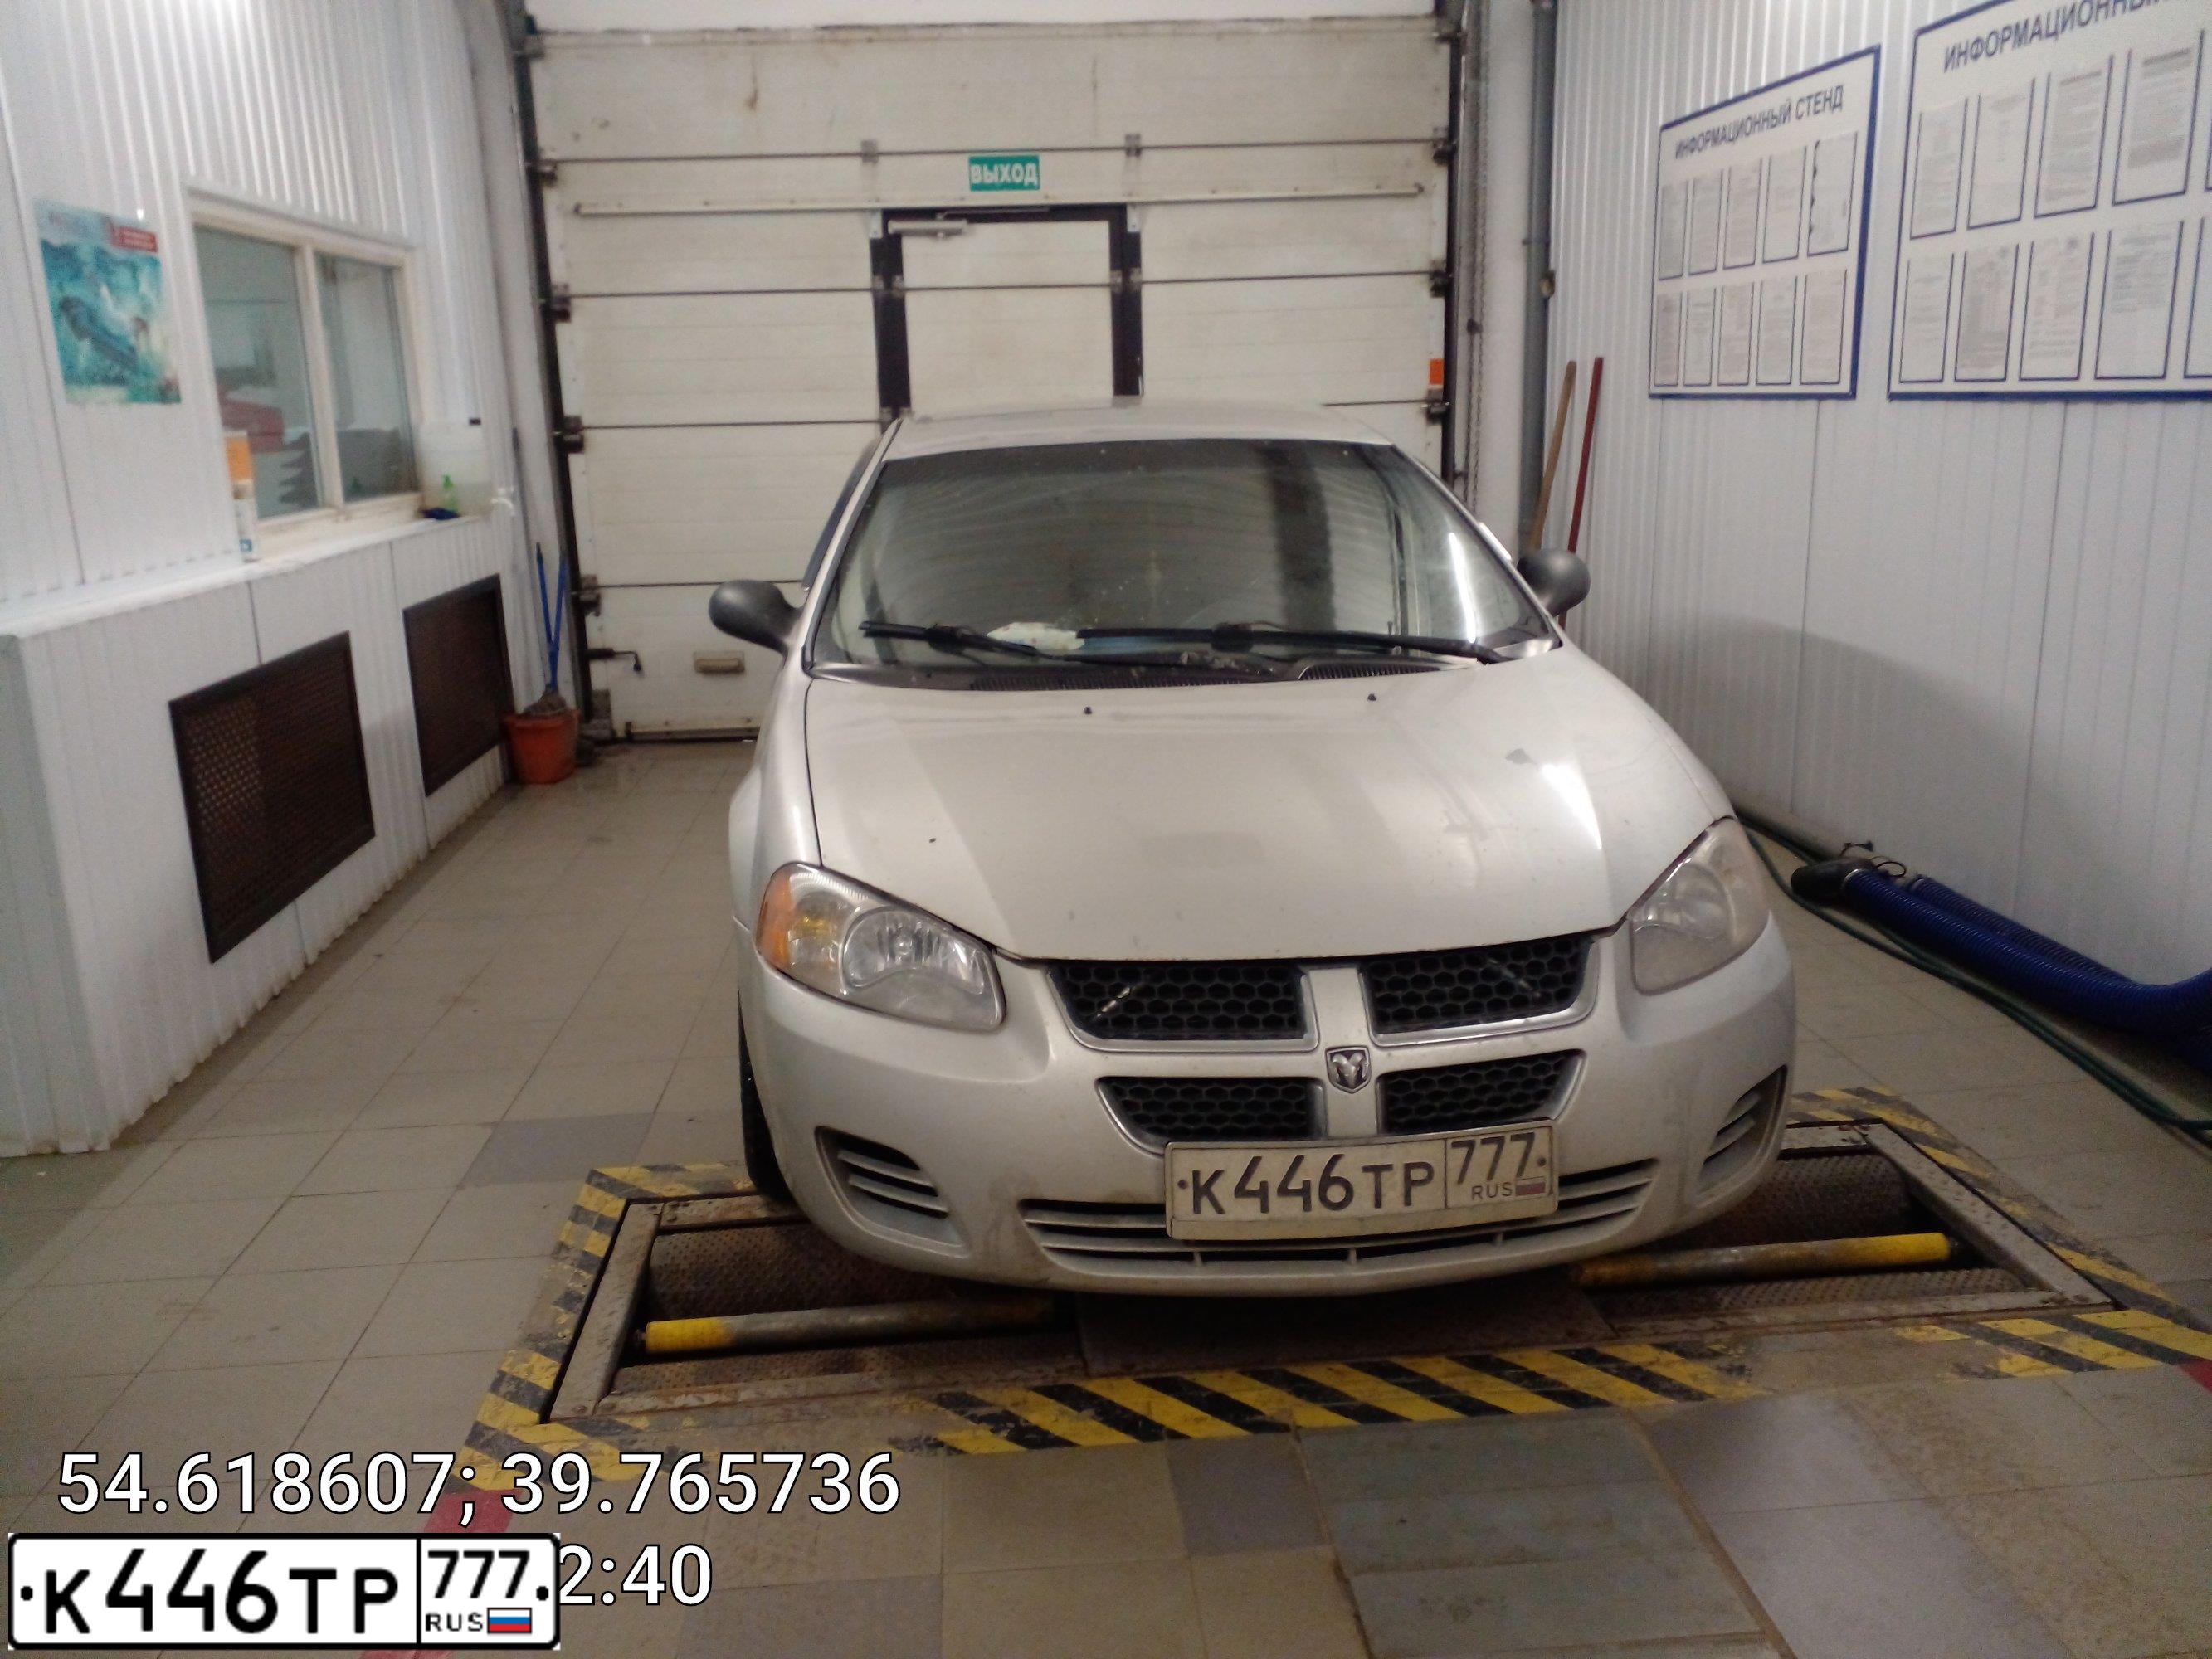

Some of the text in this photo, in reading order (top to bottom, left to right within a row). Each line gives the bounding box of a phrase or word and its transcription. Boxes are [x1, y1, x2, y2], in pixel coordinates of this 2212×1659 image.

[1943, 0, 2159, 73] ИНФОРМАЦИОНН
[1675, 85, 1844, 159] ИНФОРМАЦИОННЫЙ СТЕНД
[970, 163, 1038, 187] ВЫХОД
[1191, 1131, 1536, 1215] К446ТР 777
[1471, 1181, 1513, 1201] RUS
